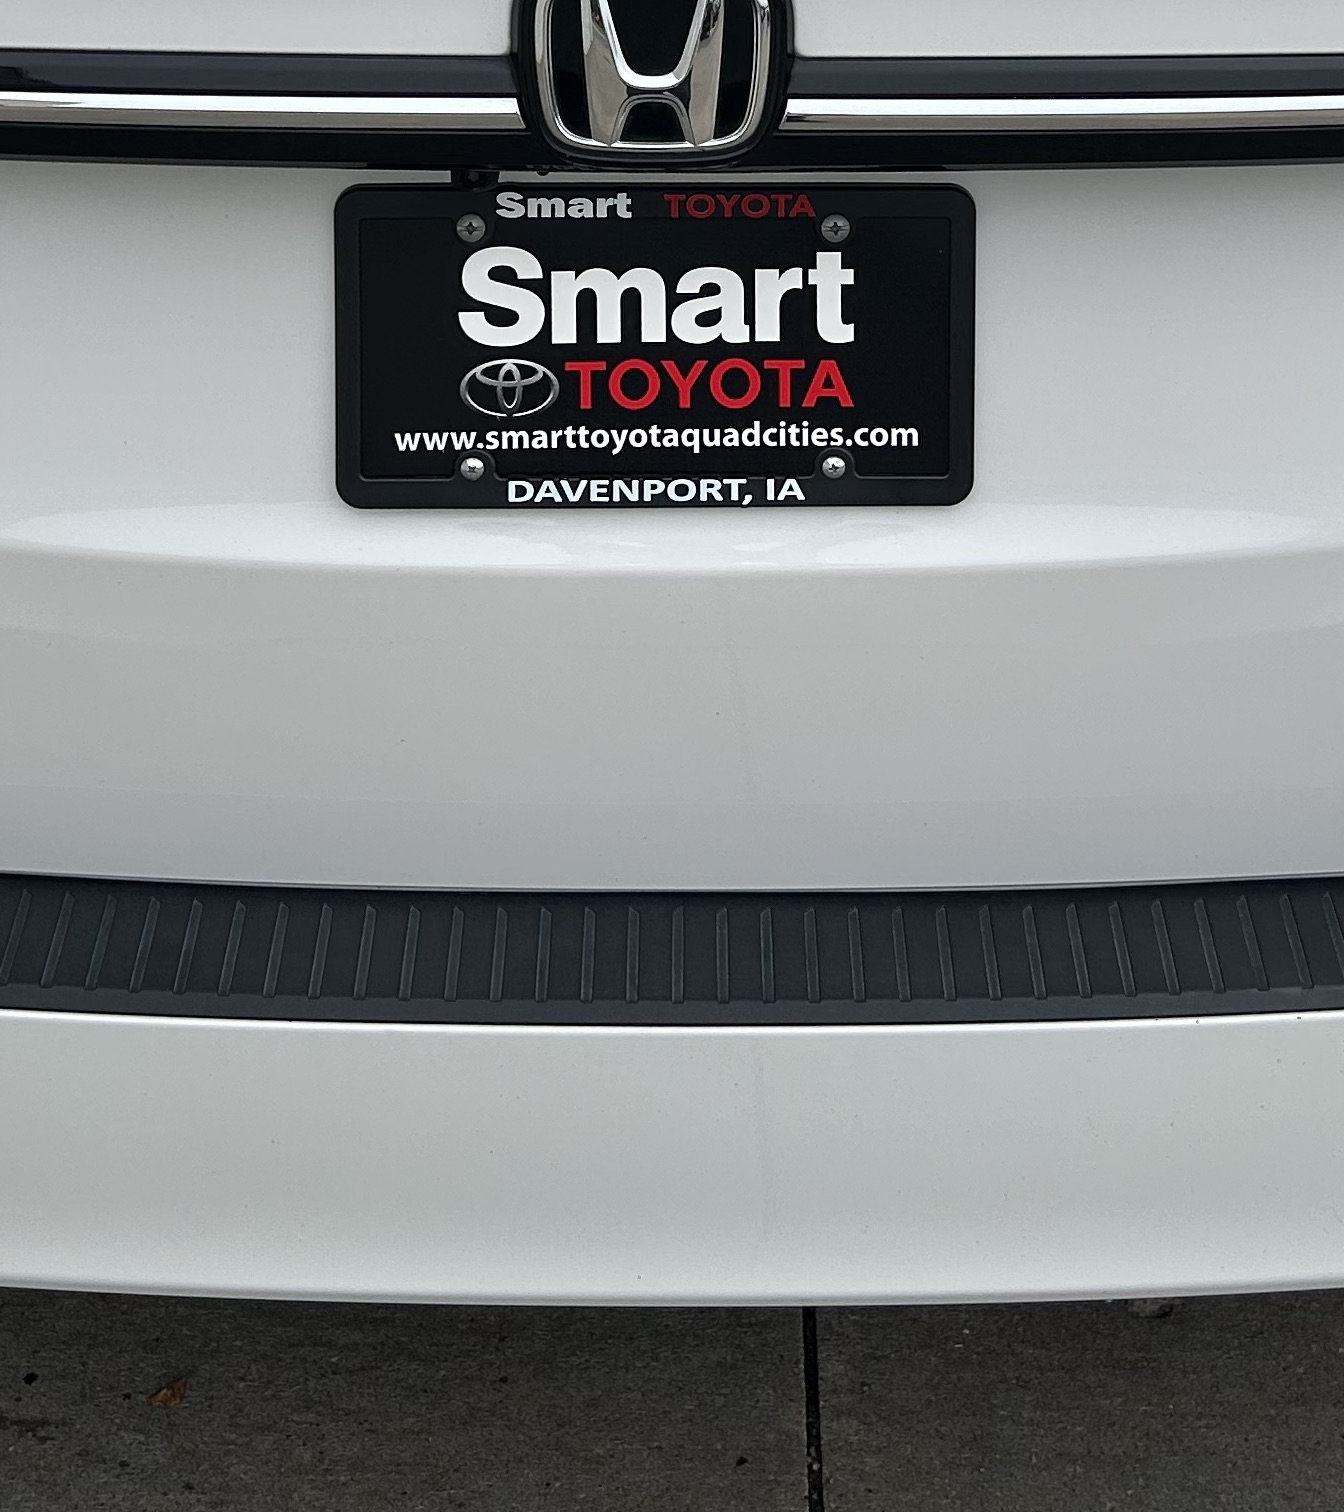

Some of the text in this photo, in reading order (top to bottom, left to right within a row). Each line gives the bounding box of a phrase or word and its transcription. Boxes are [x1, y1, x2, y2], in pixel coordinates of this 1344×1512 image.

[495, 192, 817, 219] Smart TOYOTA
[457, 245, 855, 347] Smart
[564, 357, 854, 410] TOYOTA
[394, 420, 919, 454] www.smarttoyotaquadcities.com
[507, 478, 805, 506] DAVENPORT, IA
